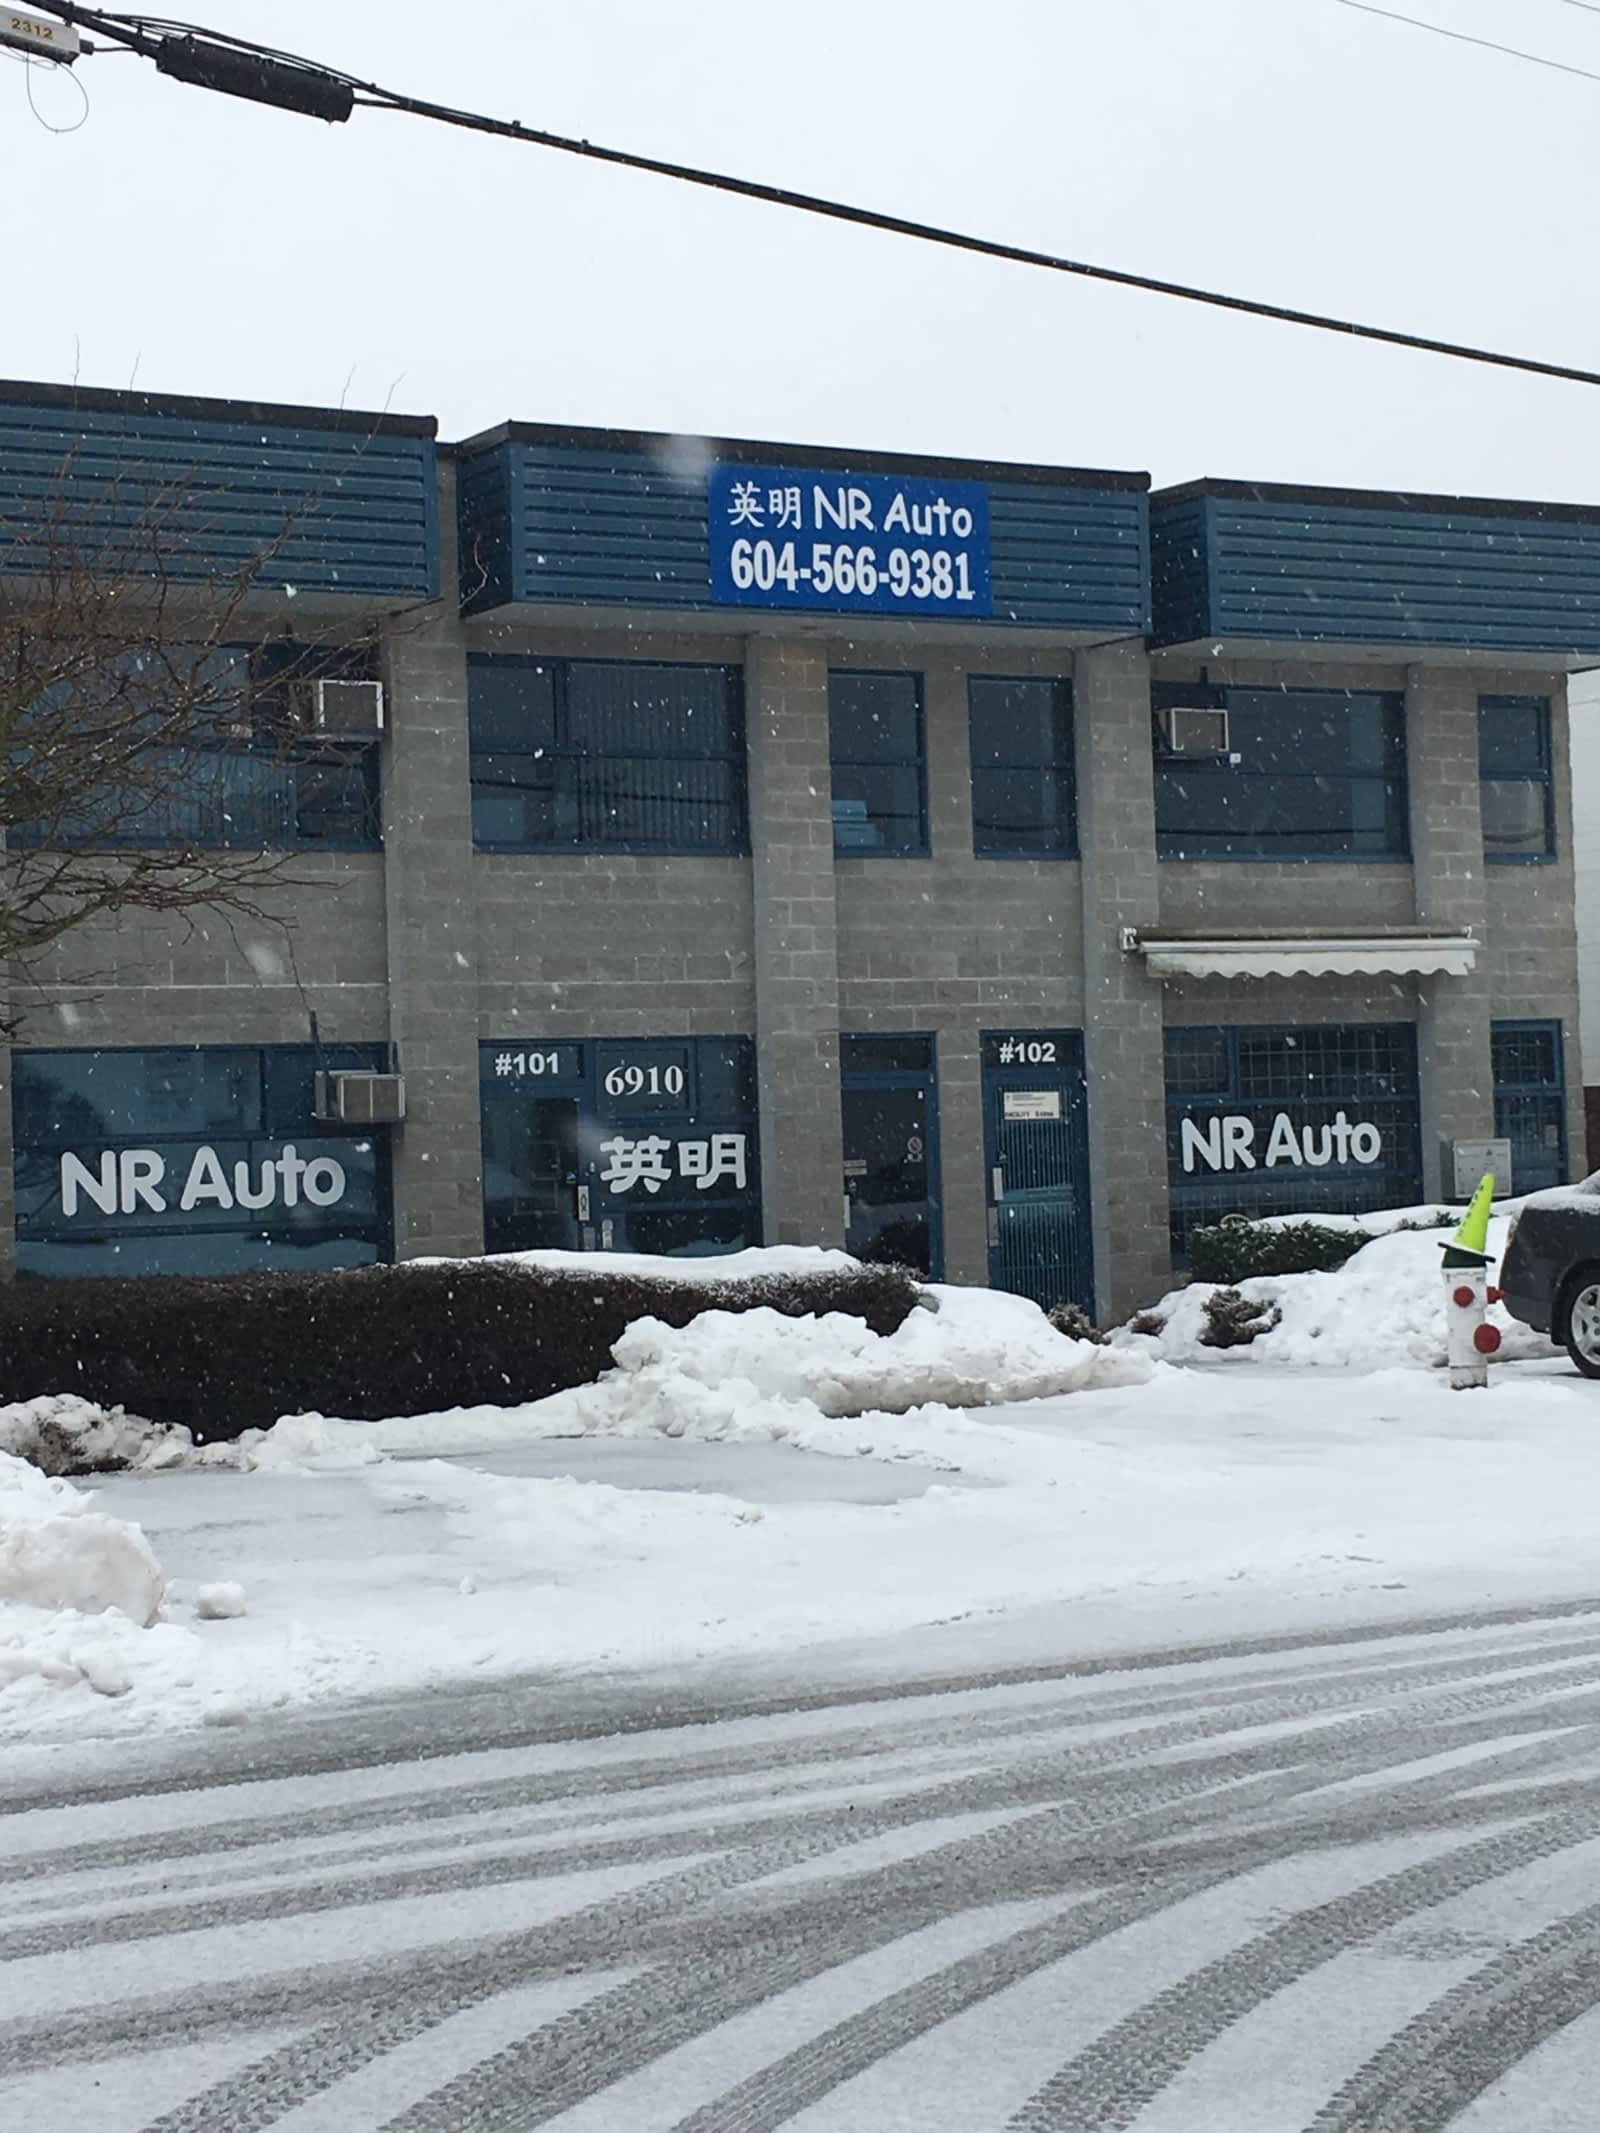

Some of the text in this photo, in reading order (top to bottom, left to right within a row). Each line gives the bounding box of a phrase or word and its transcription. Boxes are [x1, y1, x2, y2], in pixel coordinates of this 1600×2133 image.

[11, 18, 53, 39] 2312
[727, 480, 973, 537] 英明 NR Auto
[730, 538, 975, 600] 604-566-9381
[495, 1052, 559, 1076] #101
[605, 1065, 684, 1096] 6910
[1000, 1042, 1056, 1064] #102
[600, 1134, 747, 1194] 英明
[1181, 1111, 1381, 1172] NR Auto
[61, 1144, 346, 1216] NR Auto
